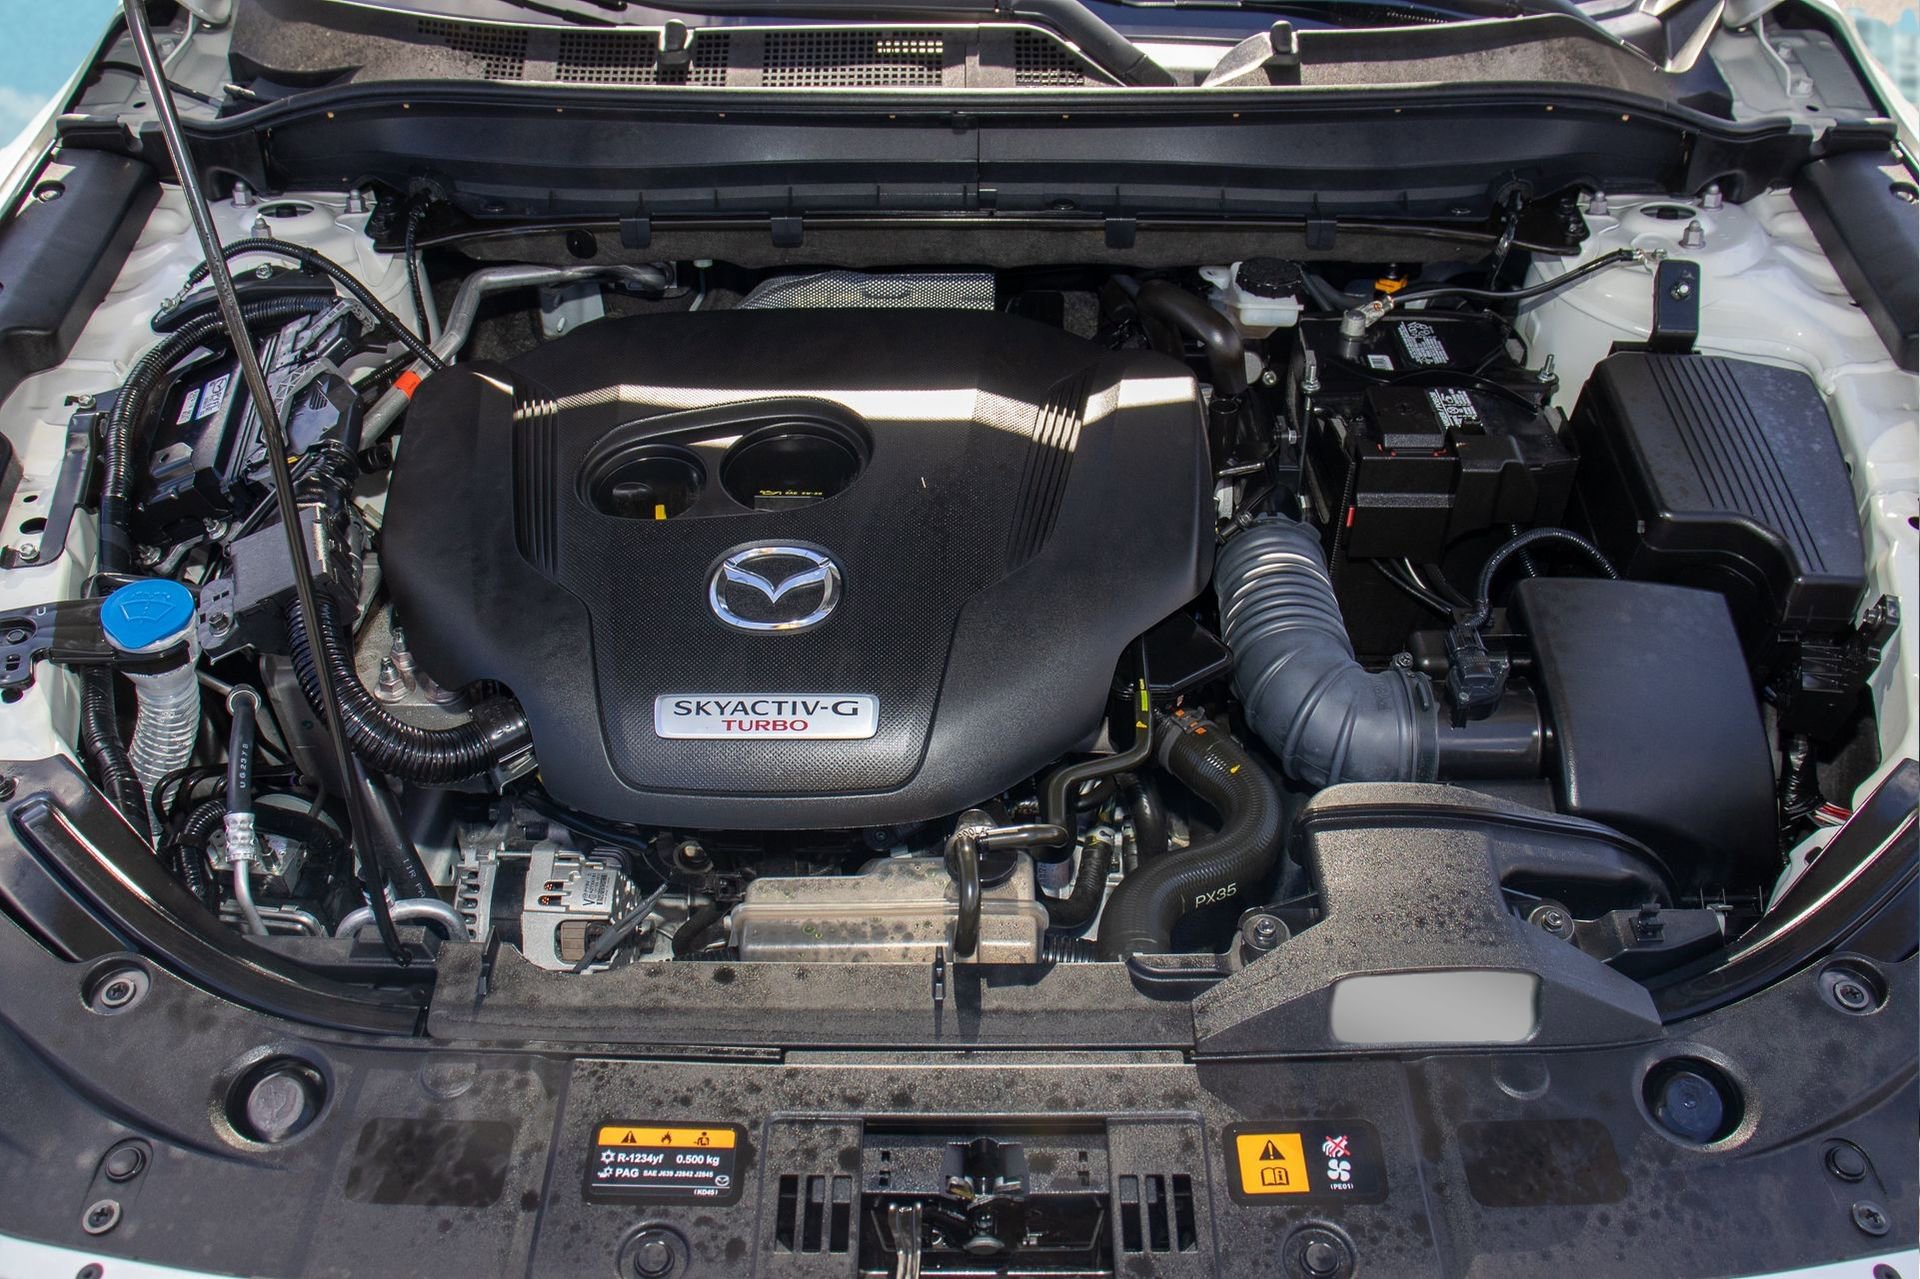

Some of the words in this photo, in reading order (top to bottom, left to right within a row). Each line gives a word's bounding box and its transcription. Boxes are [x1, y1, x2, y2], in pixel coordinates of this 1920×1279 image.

[673, 700, 859, 716] SKYACTIV-G
[721, 719, 809, 732] TURBO
[1195, 882, 1237, 909] PX35
[617, 1152, 664, 1165] R-1234yf
[676, 1154, 704, 1164] 0.500
[706, 1154, 720, 1167] kg
[615, 1167, 639, 1178] PAG
[643, 1169, 658, 1177] SAE
[1330, 1183, 1354, 1191] (PE01)
